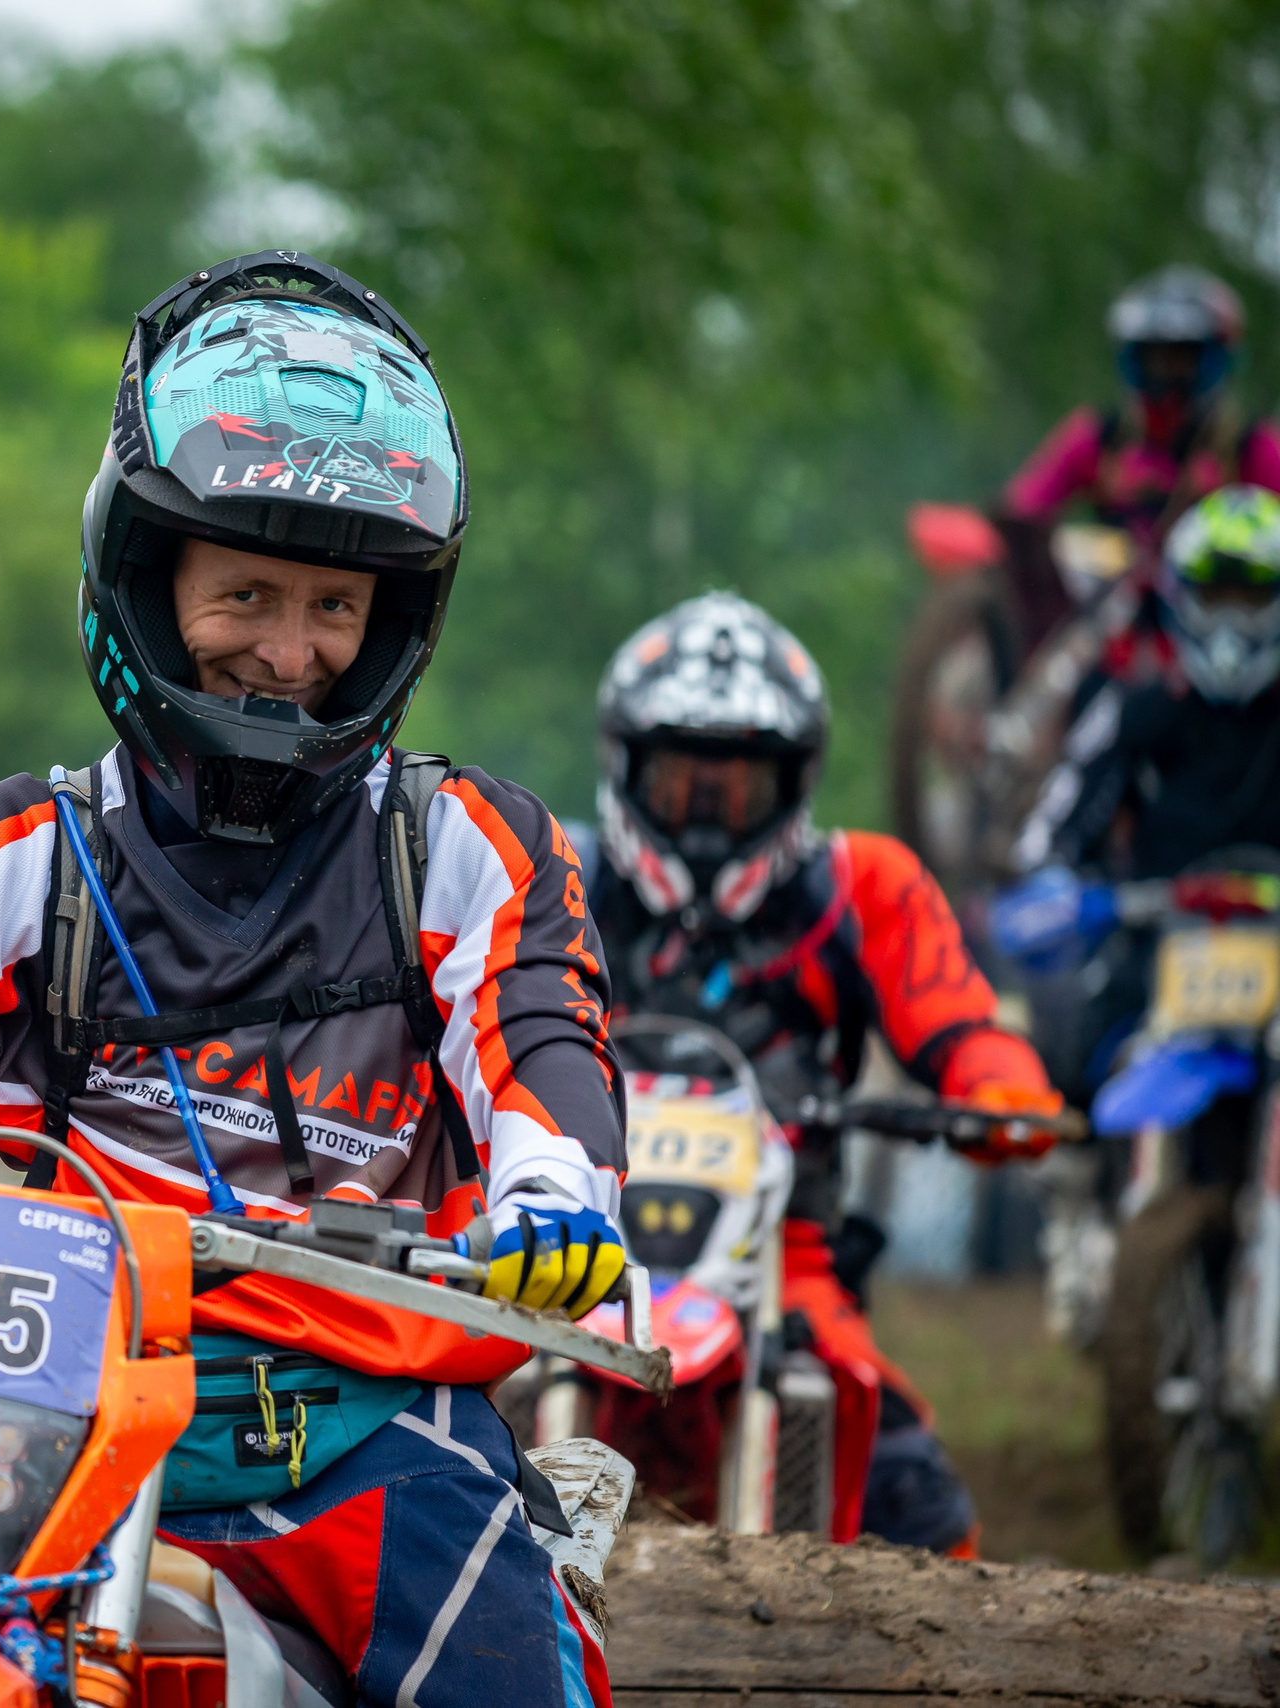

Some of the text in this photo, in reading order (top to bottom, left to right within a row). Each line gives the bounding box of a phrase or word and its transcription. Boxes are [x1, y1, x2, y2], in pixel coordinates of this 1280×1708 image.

[211, 464, 351, 503] LEATT
[135, 1083, 276, 1134] ВНЕДРОЖНОЙ
[19, 1207, 112, 1247] СЕРЕБРО
